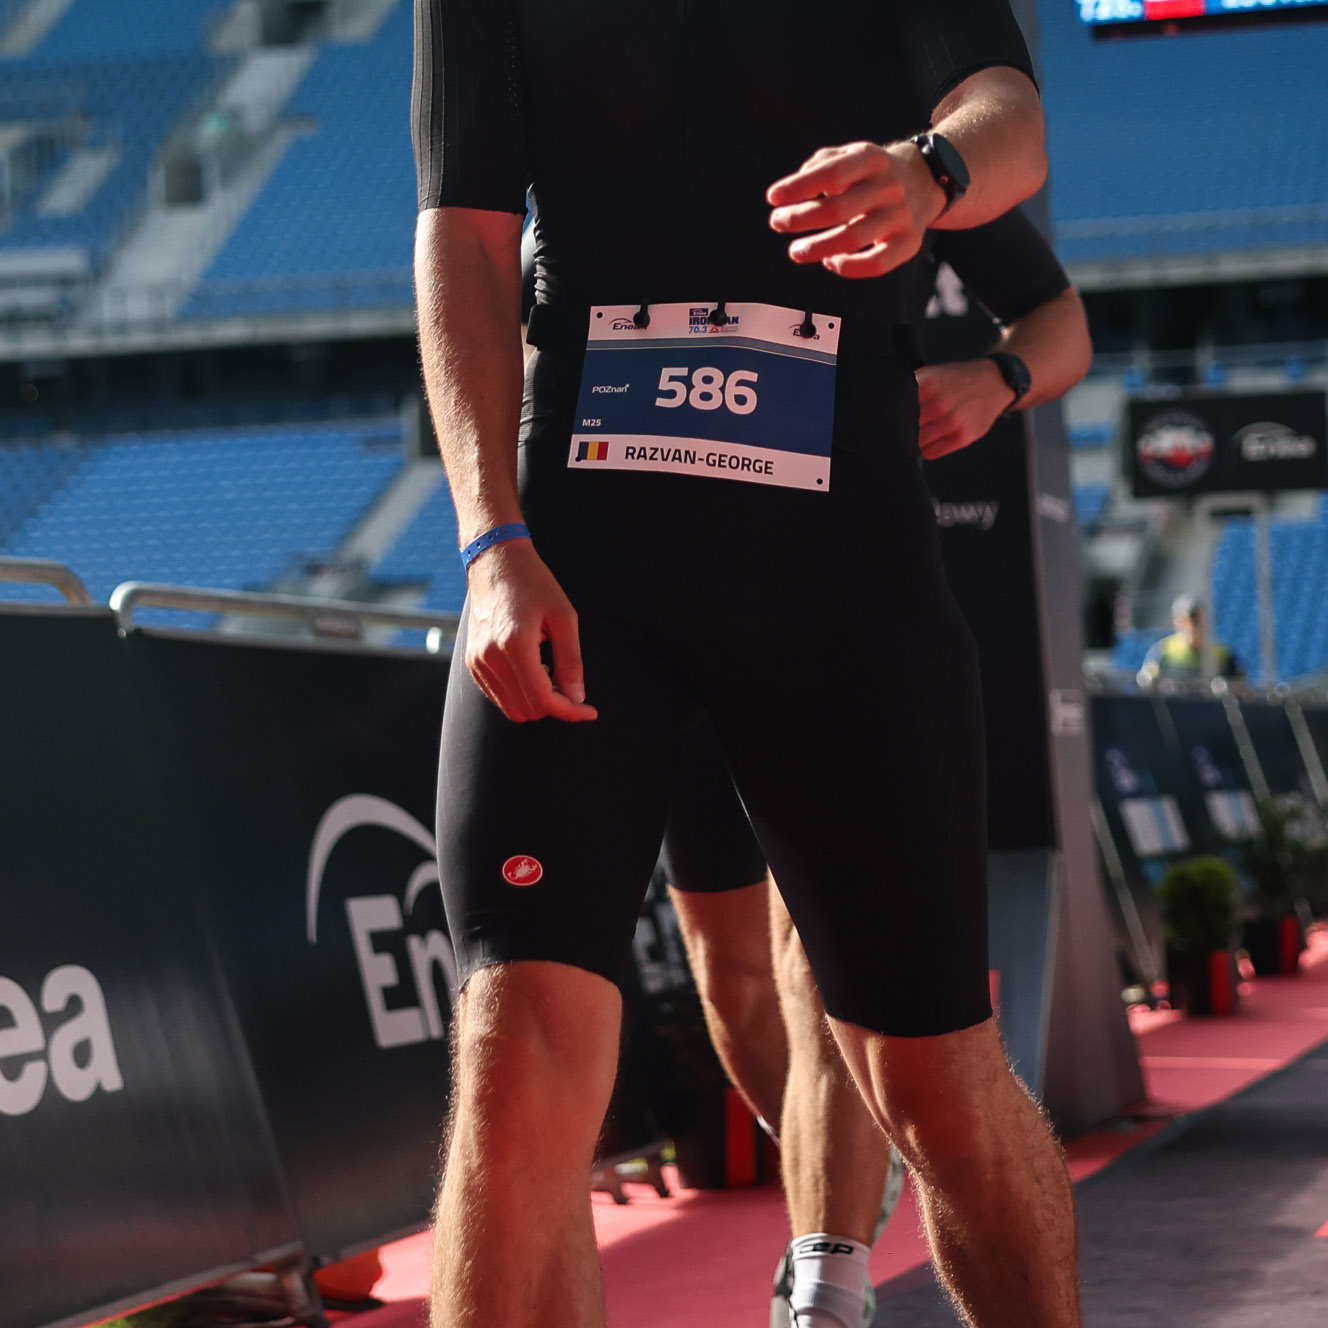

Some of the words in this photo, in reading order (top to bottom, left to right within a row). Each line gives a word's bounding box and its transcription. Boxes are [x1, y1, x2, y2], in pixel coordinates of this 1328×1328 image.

[655, 366, 759, 415] 586
[582, 418, 602, 427] M25
[624, 445, 774, 475] RAZVAN-GEORGE
